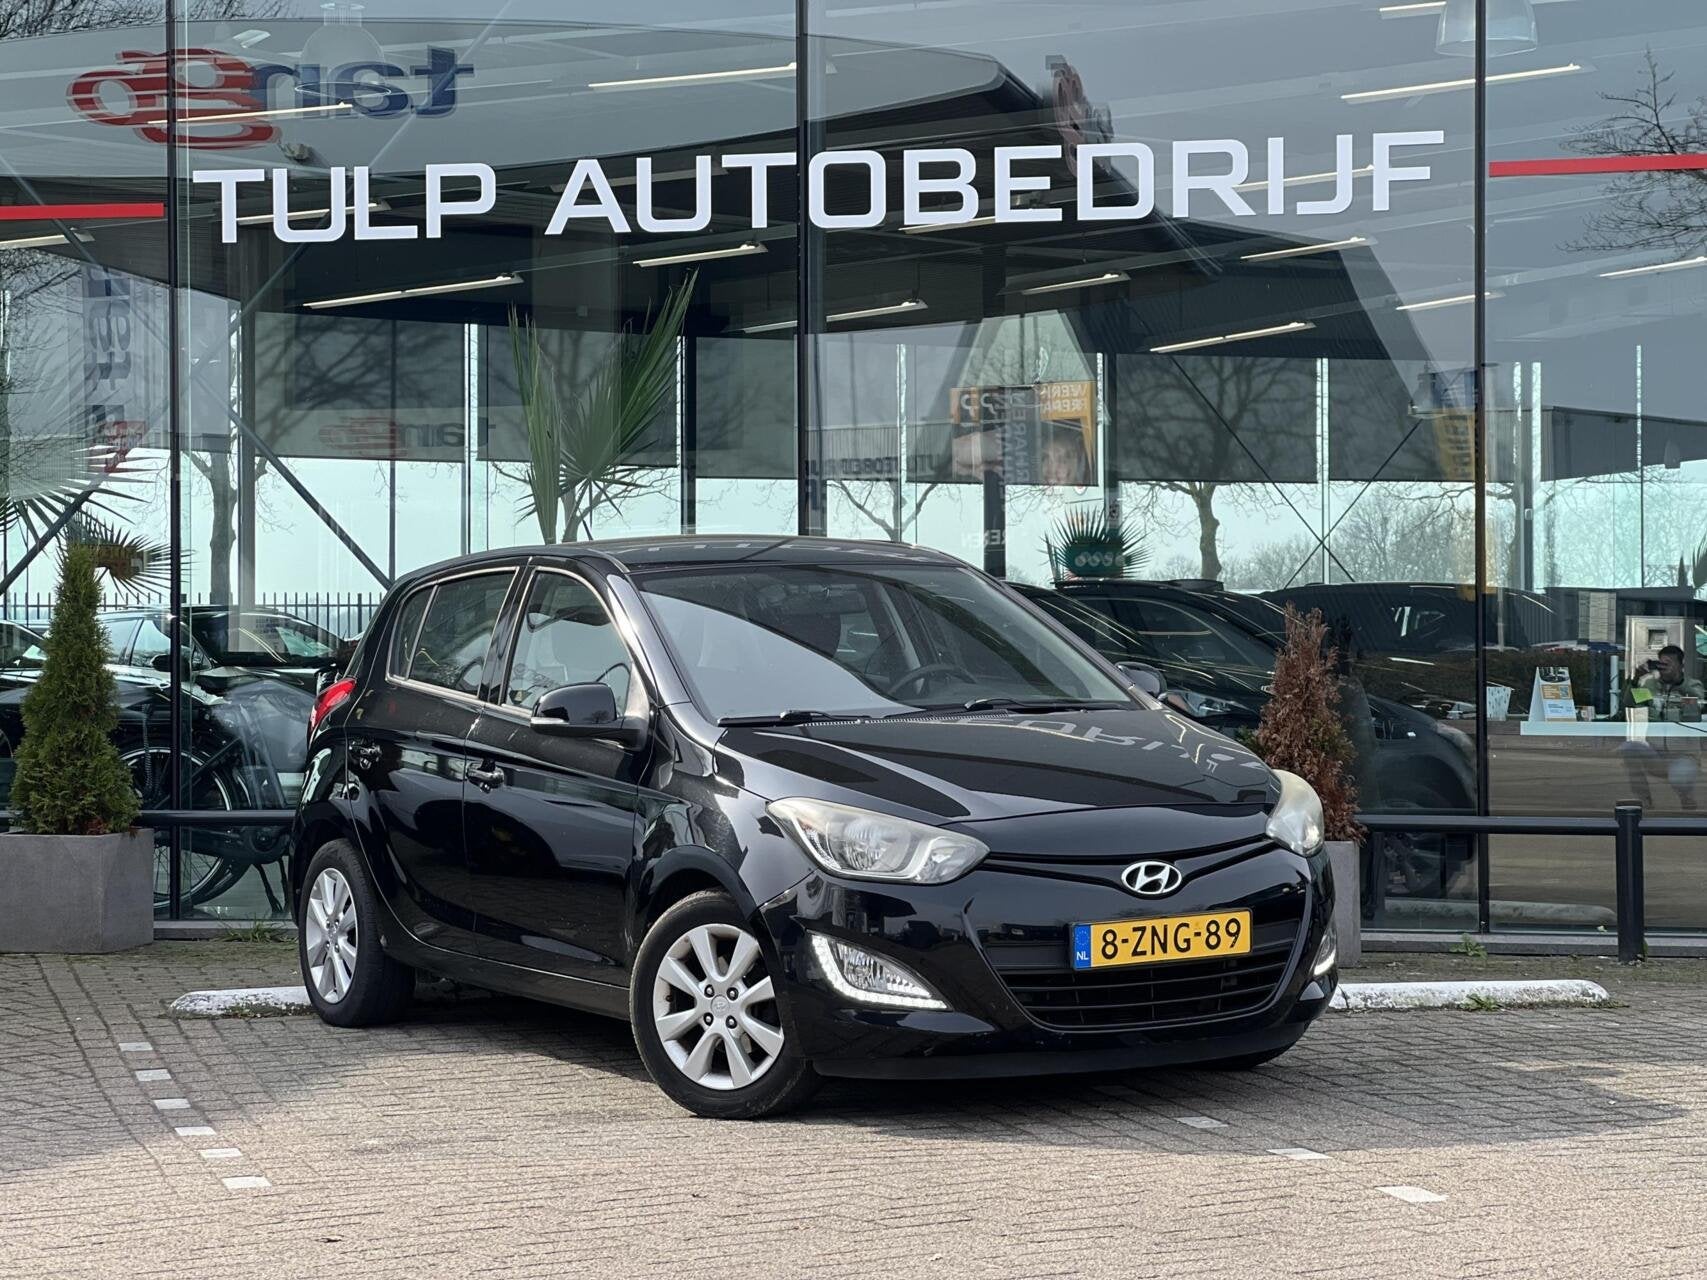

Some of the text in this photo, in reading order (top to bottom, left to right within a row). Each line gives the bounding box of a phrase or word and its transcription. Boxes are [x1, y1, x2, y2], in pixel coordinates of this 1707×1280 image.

[191, 130, 1446, 243] TULP AUTOBEDRIJF
[1076, 951, 1090, 961] NL
[1101, 917, 1242, 960] 8-ZNG-89
